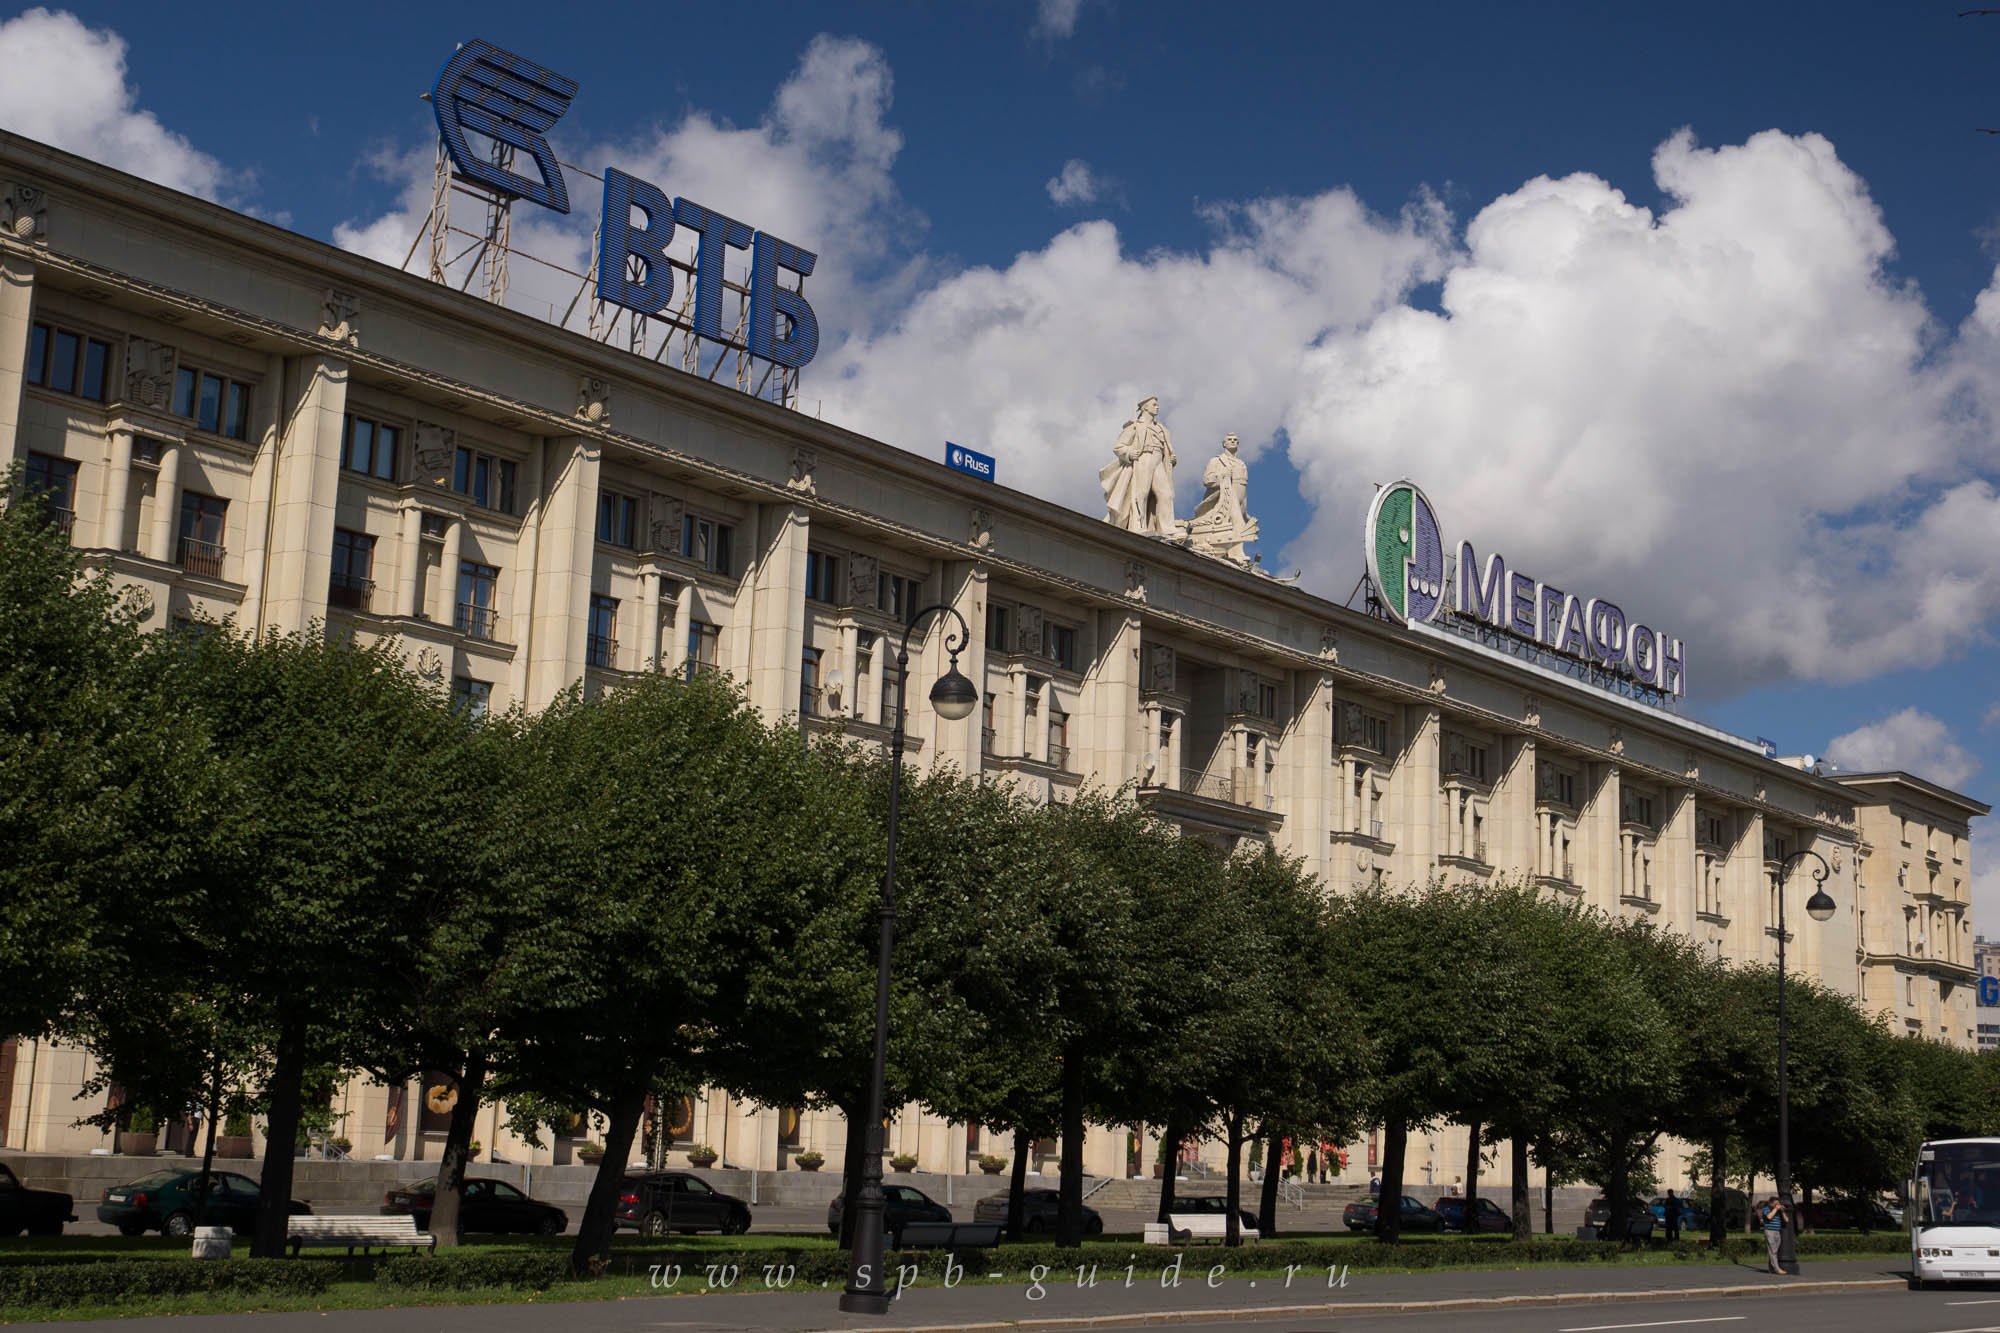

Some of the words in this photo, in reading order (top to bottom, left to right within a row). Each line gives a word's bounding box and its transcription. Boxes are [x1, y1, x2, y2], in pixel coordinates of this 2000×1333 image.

[598, 167, 819, 368] ВТБ
[965, 453, 990, 474] Russ
[1455, 539, 1686, 697] МЕГАФОН
